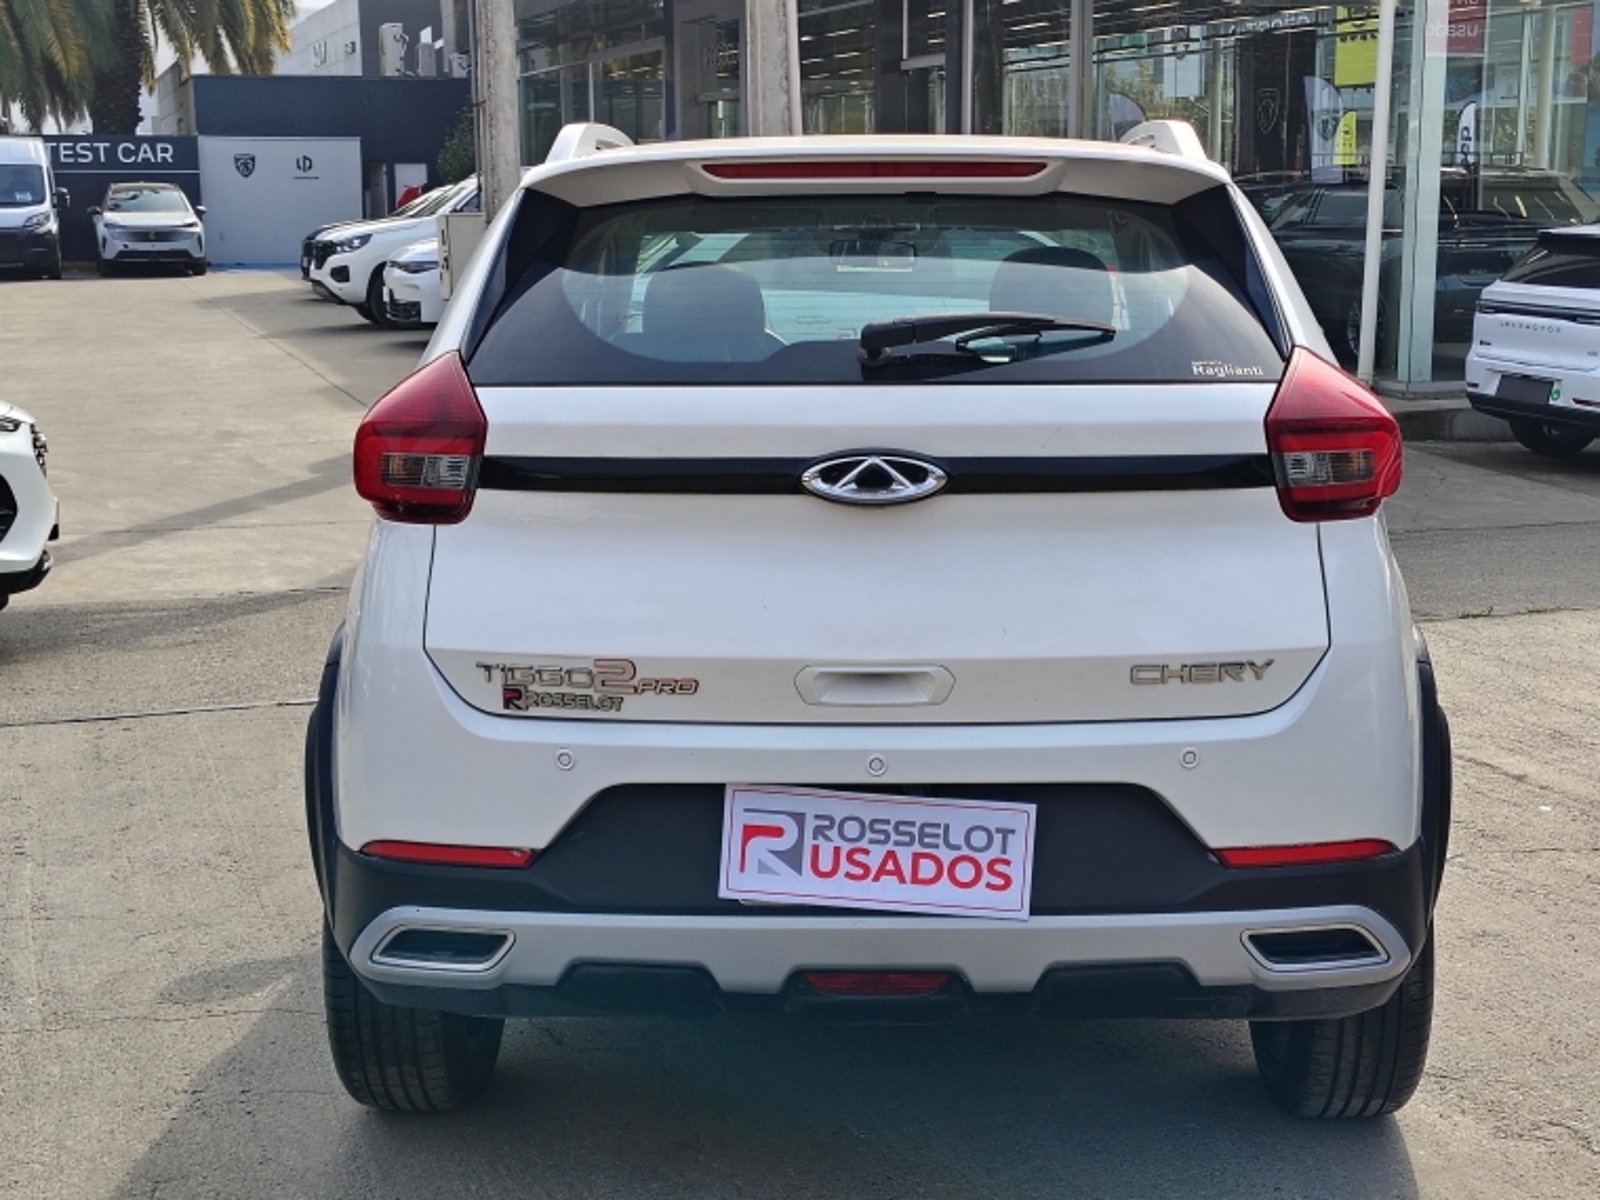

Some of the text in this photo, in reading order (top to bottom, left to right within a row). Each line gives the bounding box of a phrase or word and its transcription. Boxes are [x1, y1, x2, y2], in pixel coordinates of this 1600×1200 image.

[45, 142, 174, 163] TEST CAR
[1130, 658, 1275, 685] CHERY
[637, 677, 699, 695] PRO
[526, 690, 624, 712] ROSSELOT
[811, 813, 1016, 854] ROSSELOT
[809, 844, 1013, 892] USADOS
